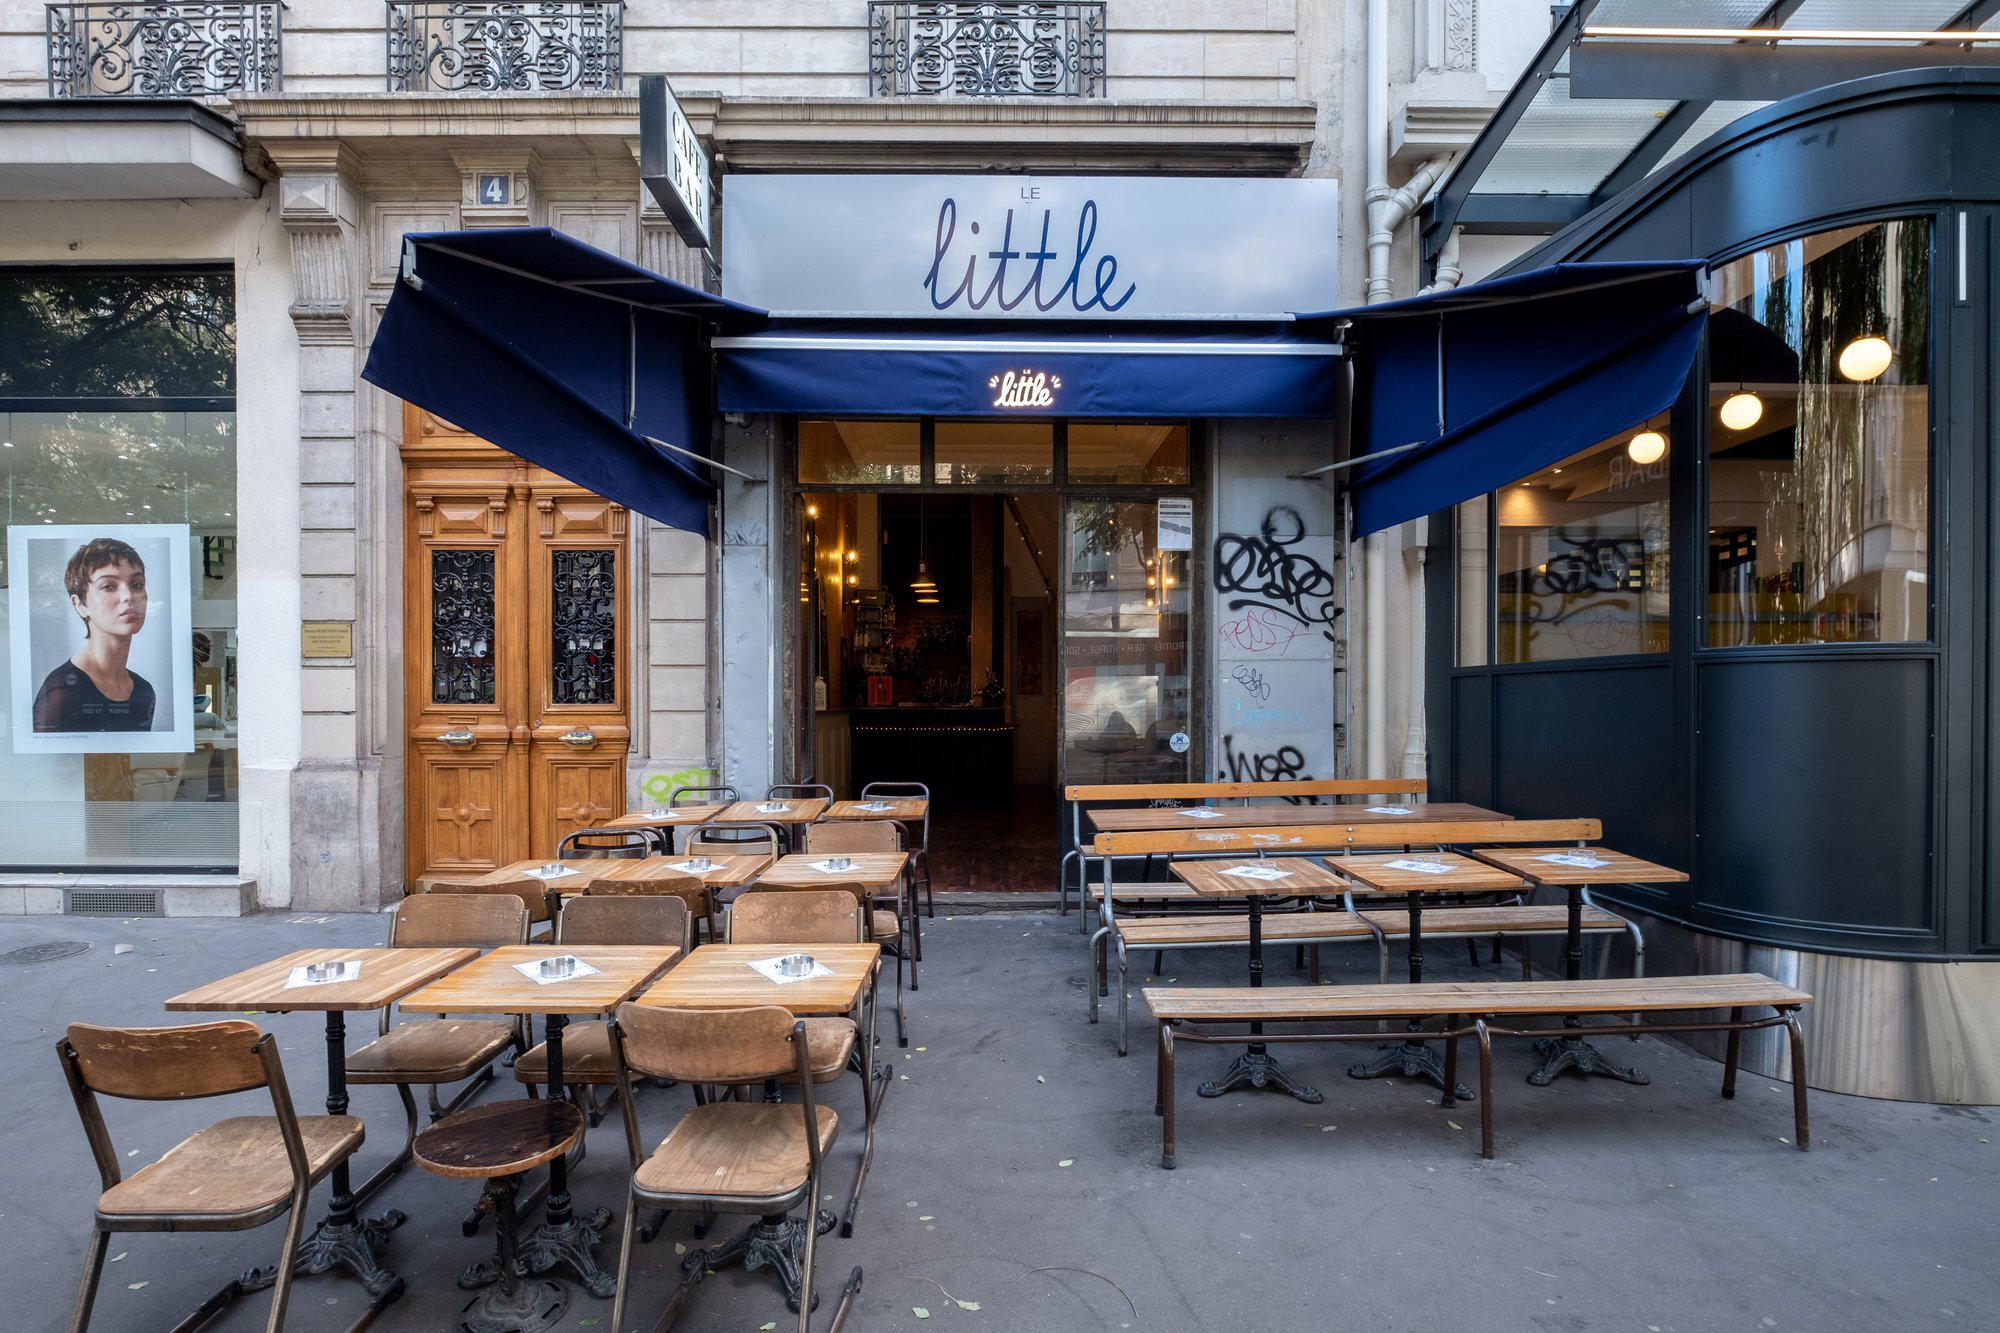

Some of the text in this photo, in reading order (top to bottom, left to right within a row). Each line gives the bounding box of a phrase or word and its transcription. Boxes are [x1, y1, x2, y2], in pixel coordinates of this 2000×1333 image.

[672, 110, 703, 185] CAFE
[486, 176, 503, 202] 4
[673, 151, 704, 225] BAR
[1020, 187, 1041, 200] LE
[923, 197, 1137, 312] little
[993, 371, 1054, 407] little
